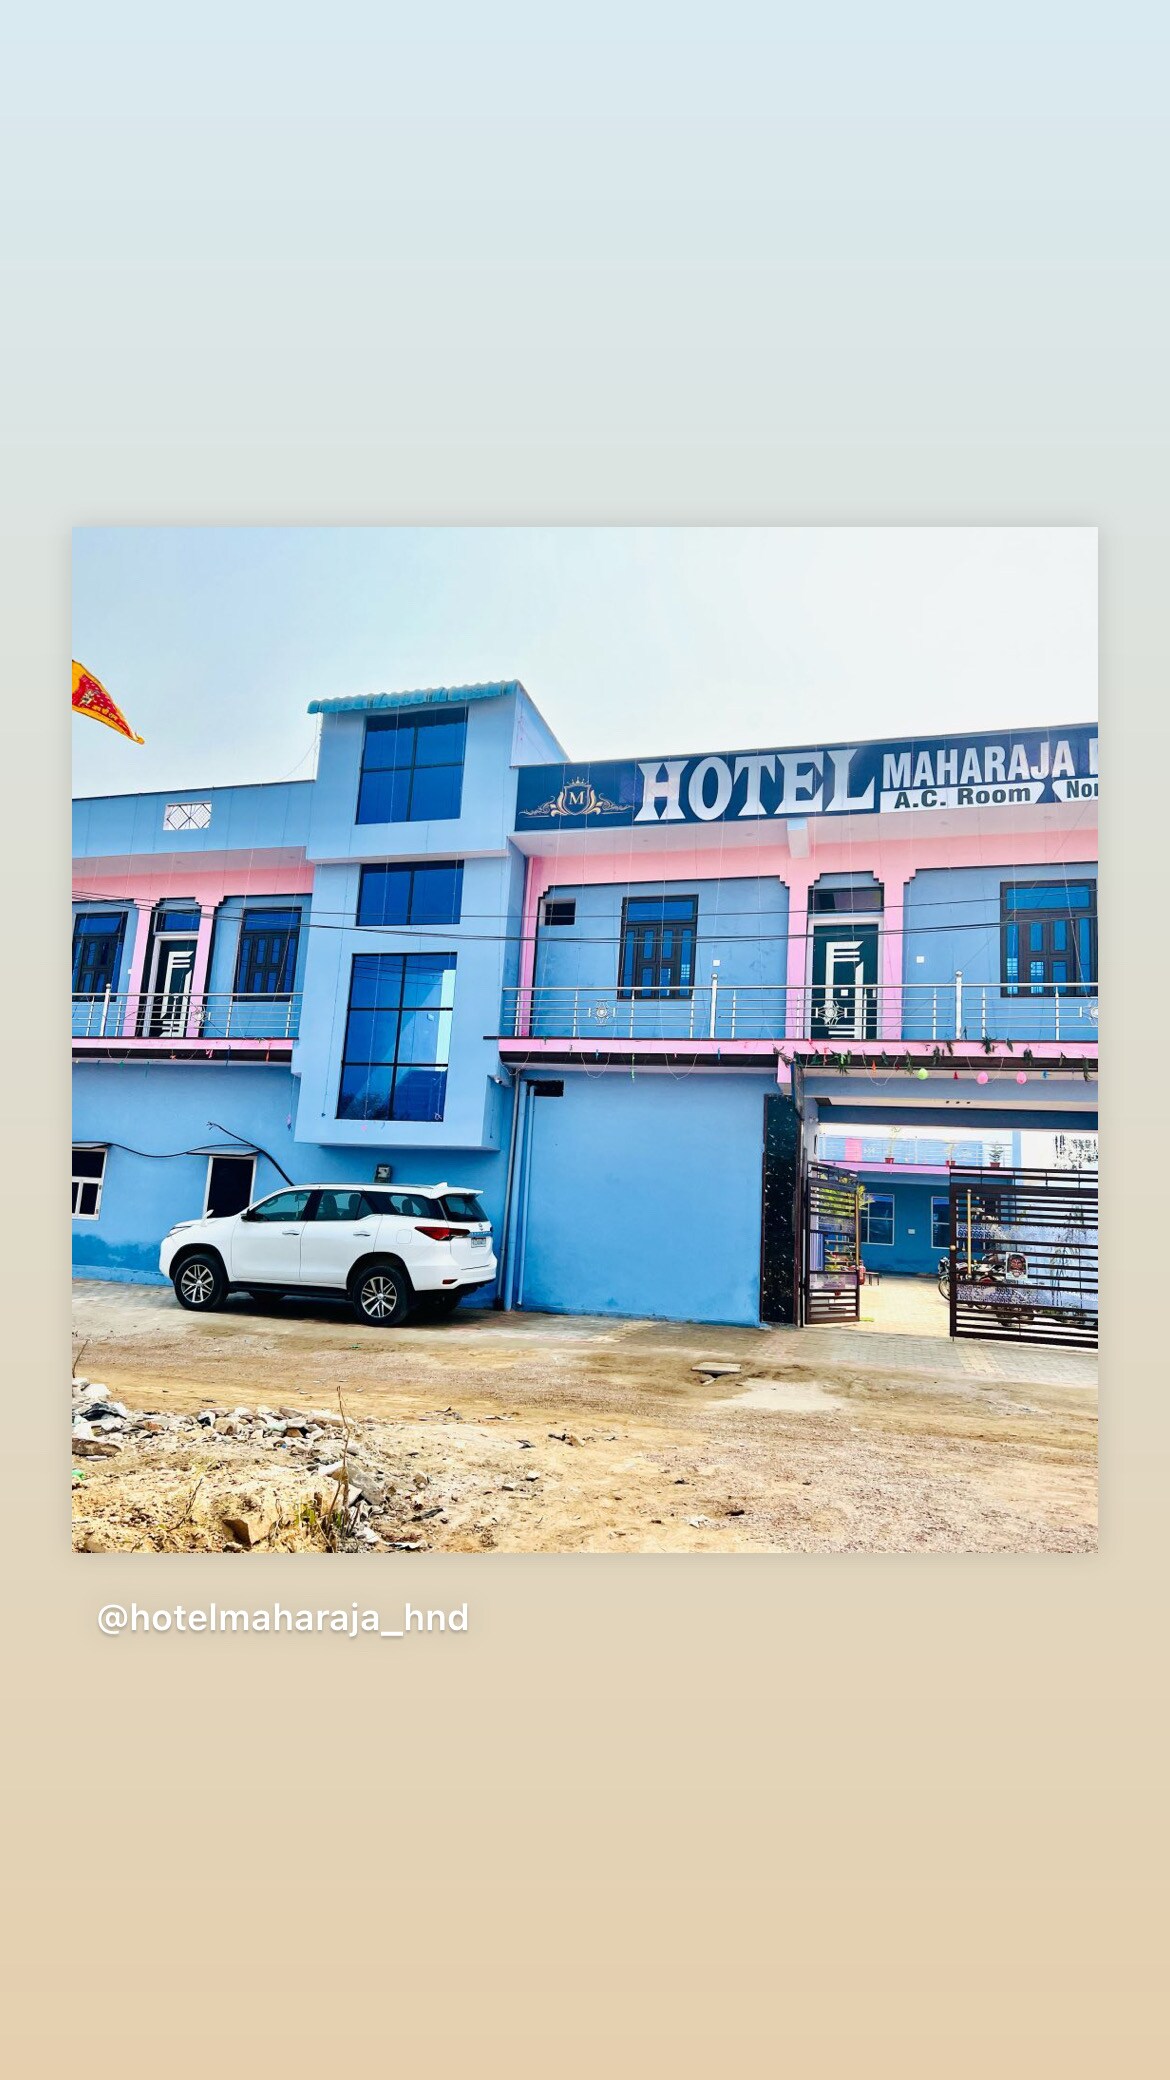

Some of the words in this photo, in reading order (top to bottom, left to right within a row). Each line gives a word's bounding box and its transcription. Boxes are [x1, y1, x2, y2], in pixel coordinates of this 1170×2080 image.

[634, 749, 875, 821] HOTEL
[883, 740, 1076, 789] MAHARAJA
[569, 791, 585, 805] M
[894, 789, 946, 809] A.C.
[957, 787, 1031, 805] Room
